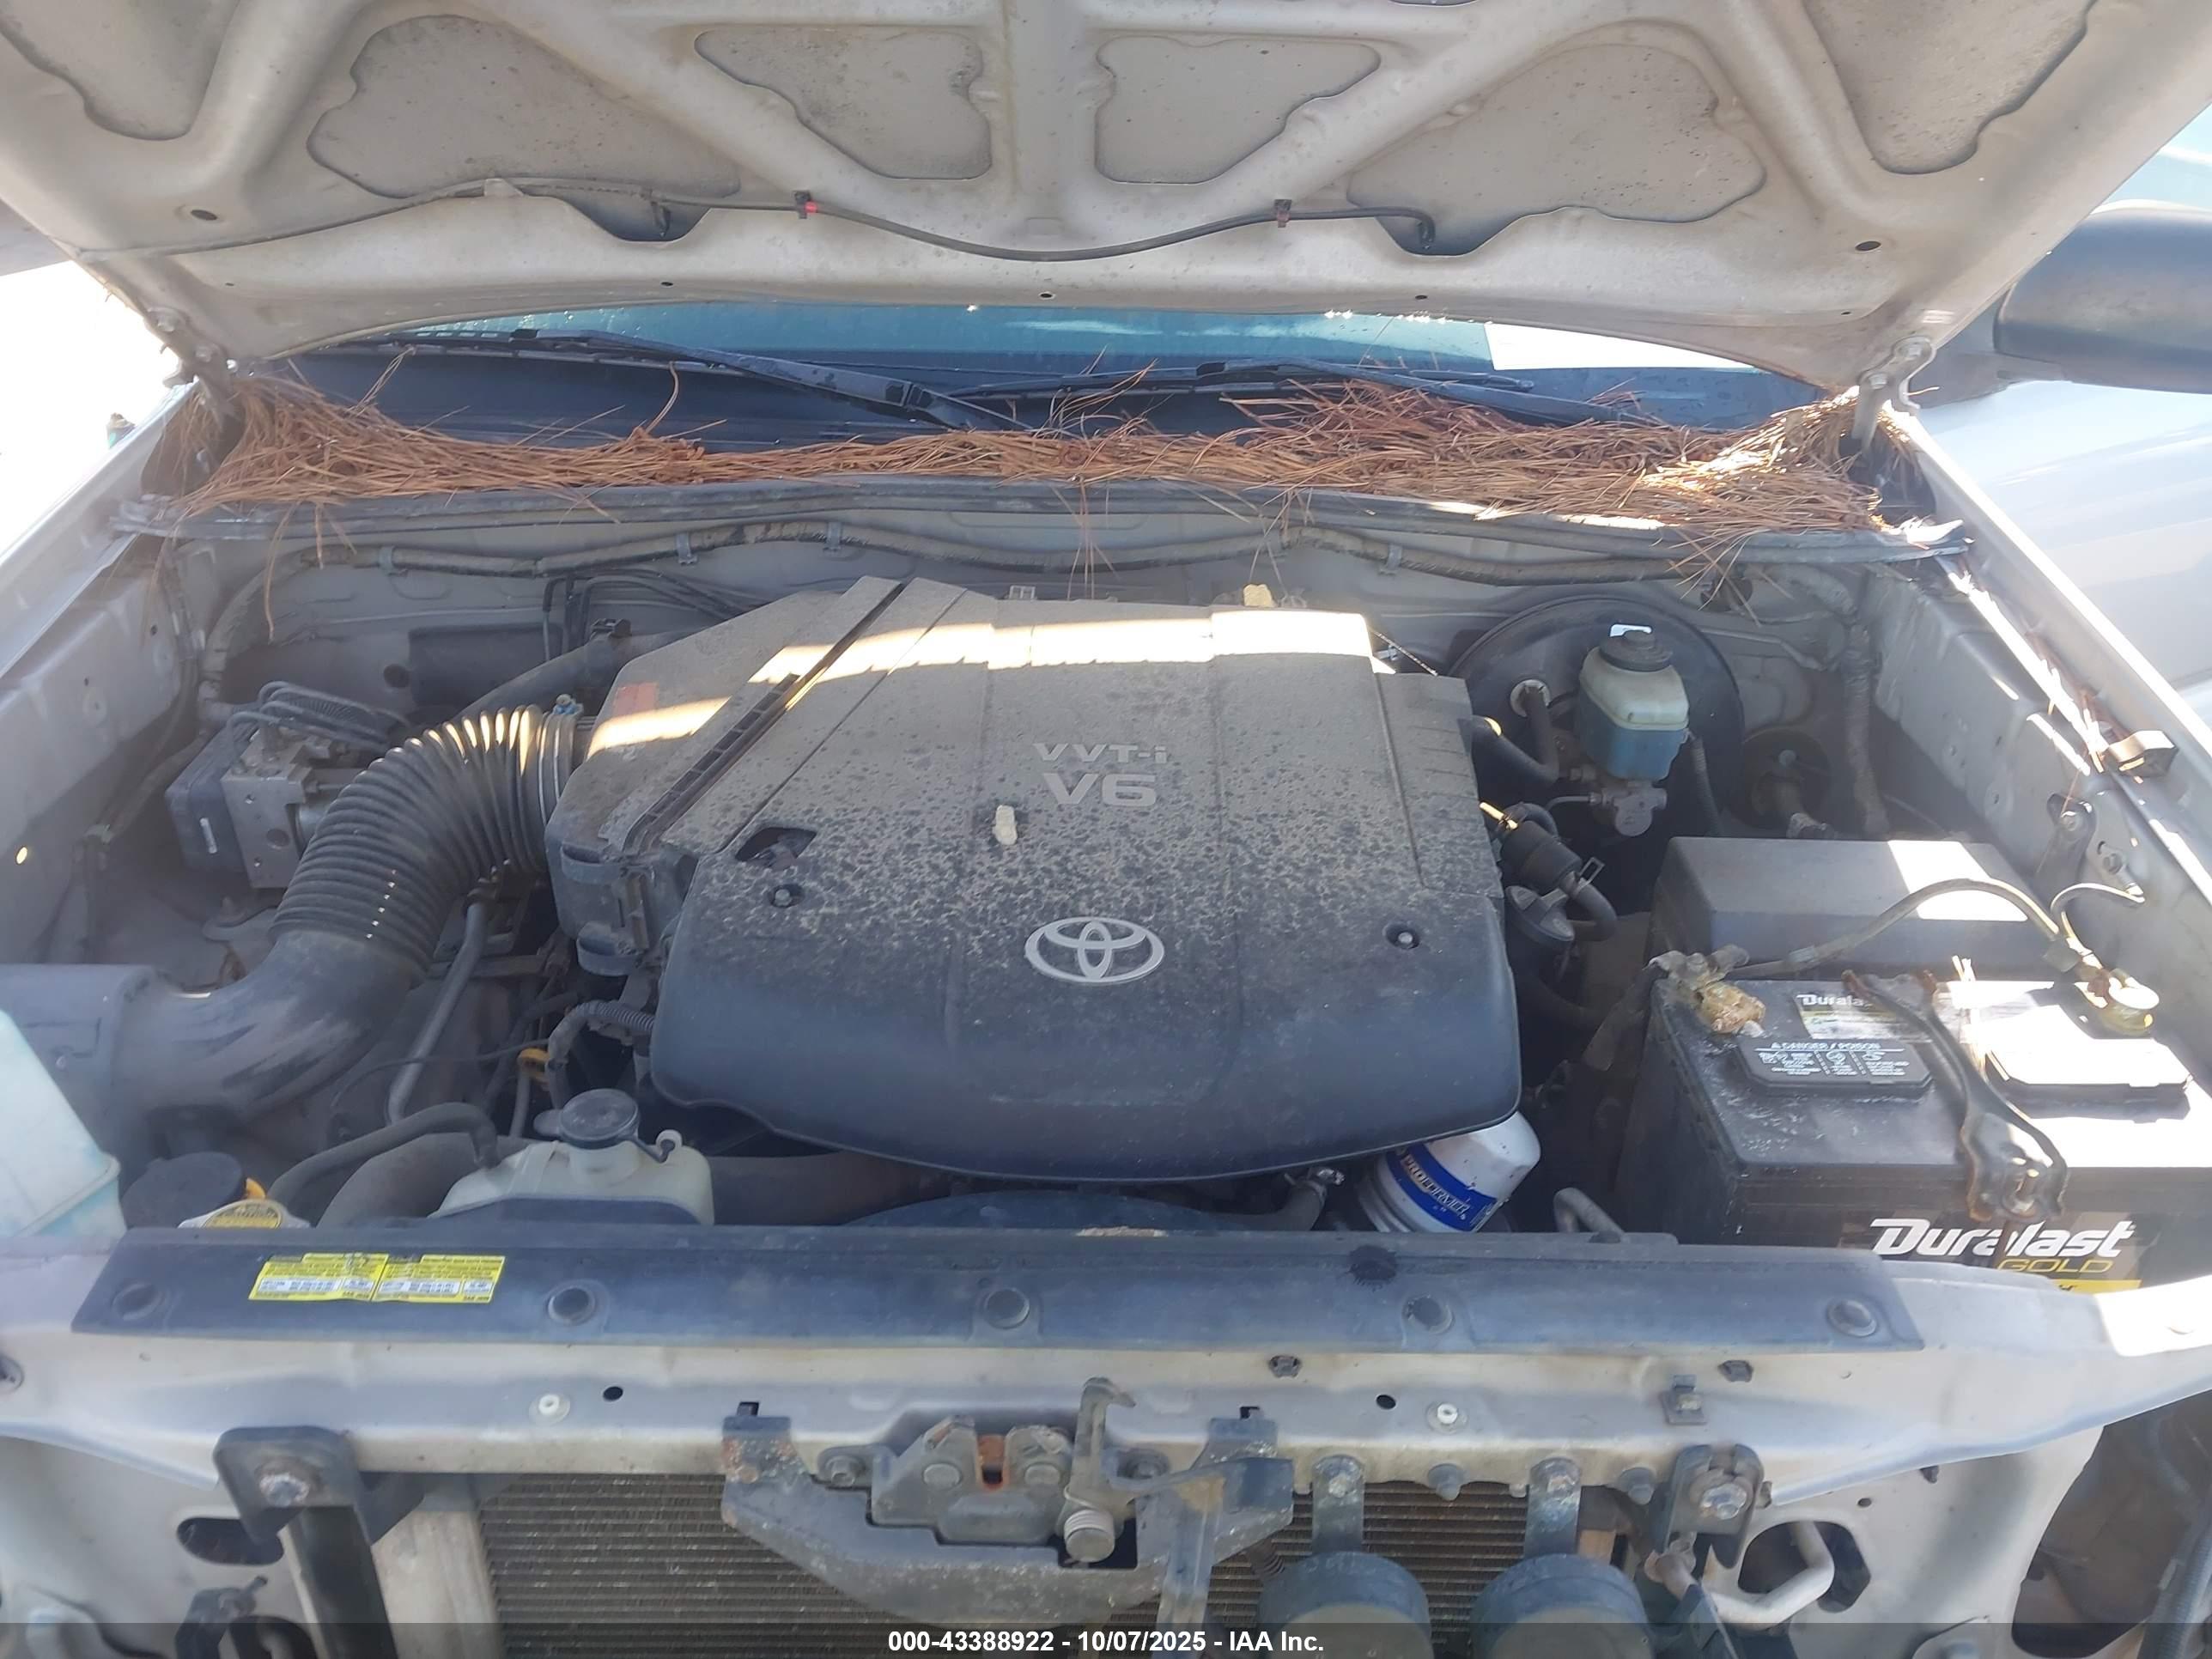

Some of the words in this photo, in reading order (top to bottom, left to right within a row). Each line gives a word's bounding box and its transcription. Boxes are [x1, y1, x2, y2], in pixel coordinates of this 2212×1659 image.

[1032, 743, 1168, 763] VVT-i
[1043, 773, 1157, 807] V6
[1870, 1218, 2134, 1258] Duralast
[1996, 1259, 2114, 1273] GOLD
